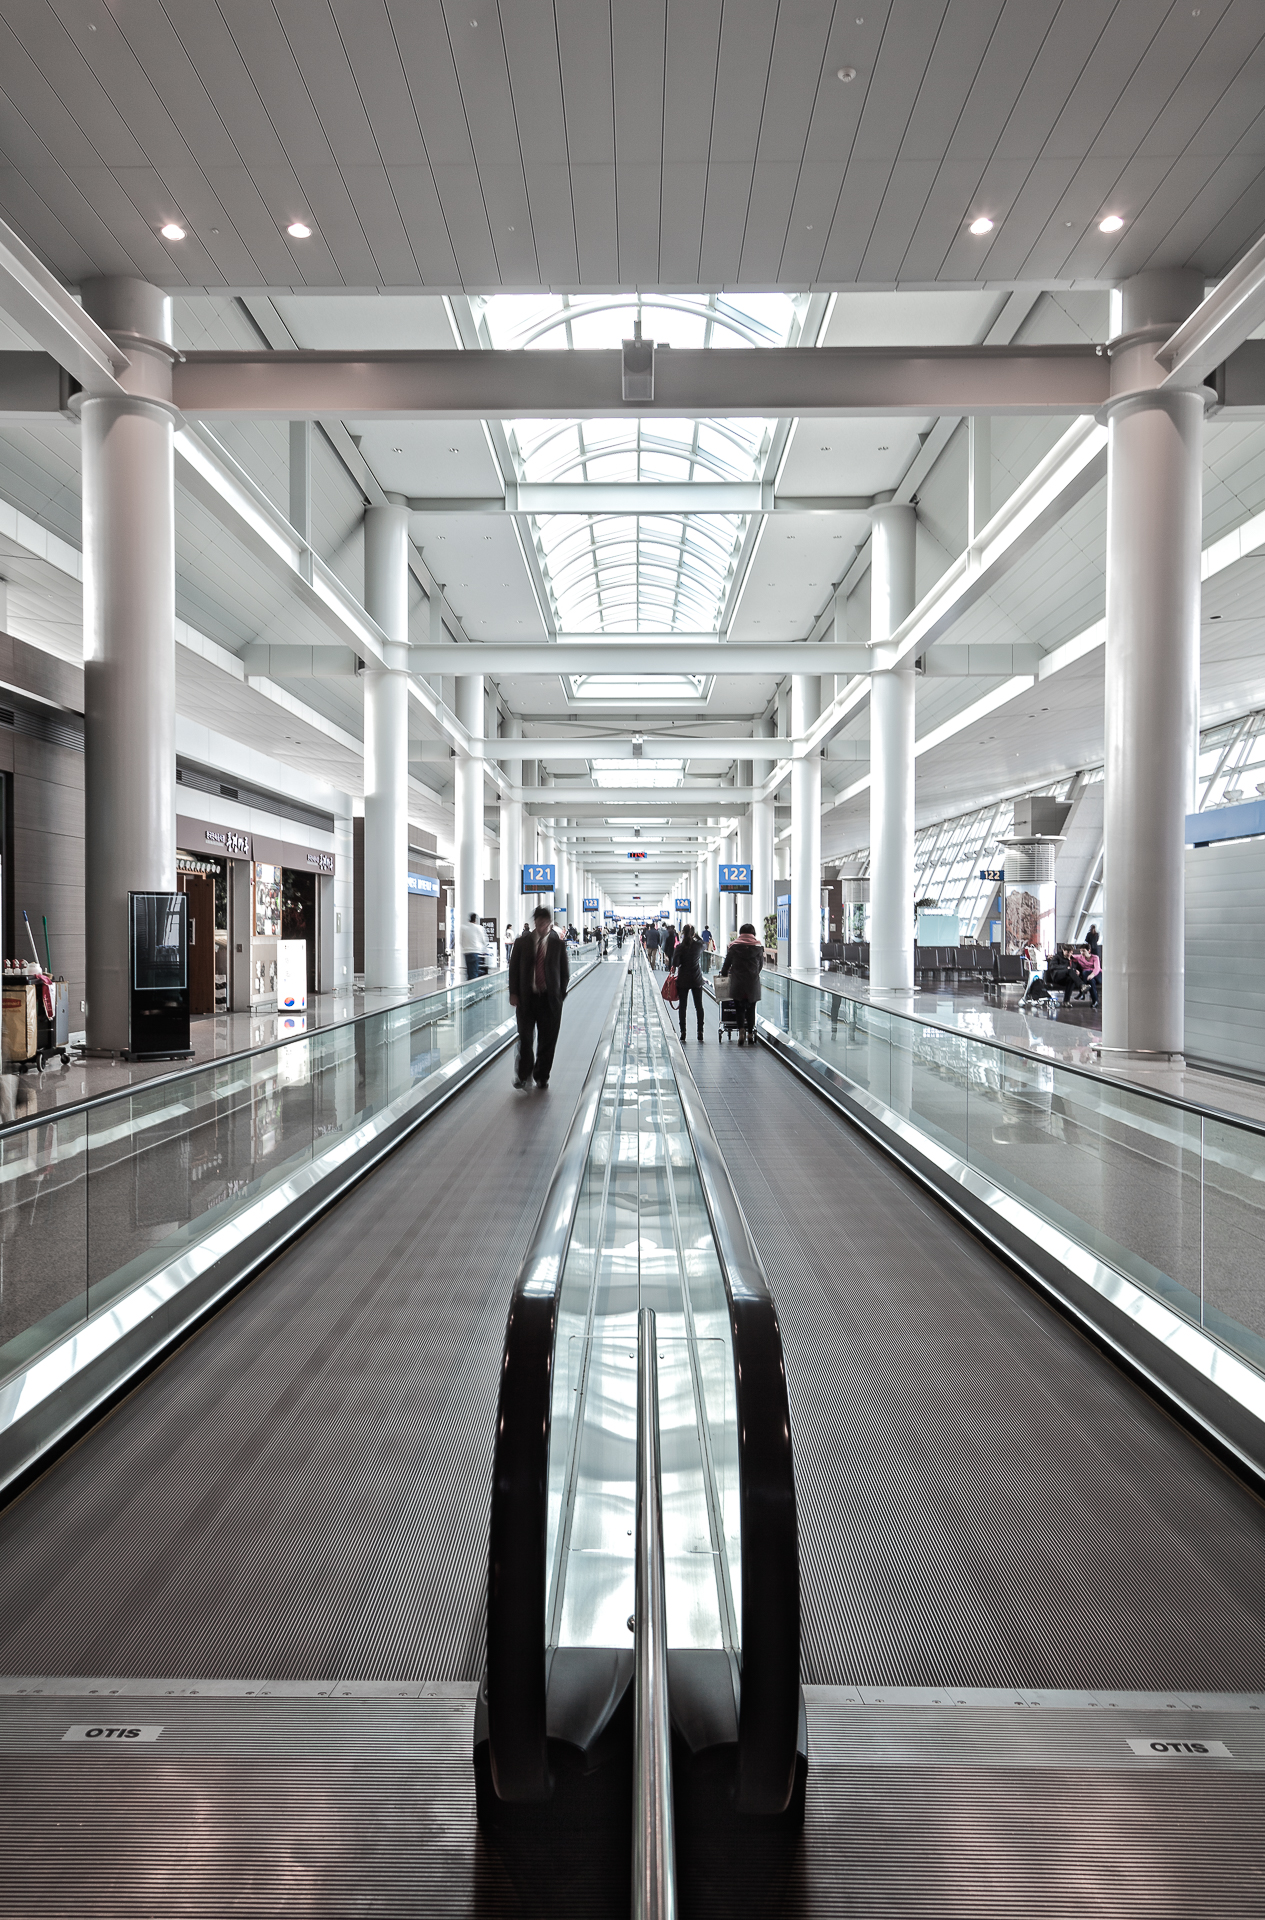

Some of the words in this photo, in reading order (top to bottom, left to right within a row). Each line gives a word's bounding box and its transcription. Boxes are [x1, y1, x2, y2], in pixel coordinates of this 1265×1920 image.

[528, 868, 550, 880] 121
[723, 868, 747, 880] 122
[984, 871, 1000, 880] 122
[85, 1728, 141, 1738] OTIS
[1150, 1742, 1209, 1753] OTIS
